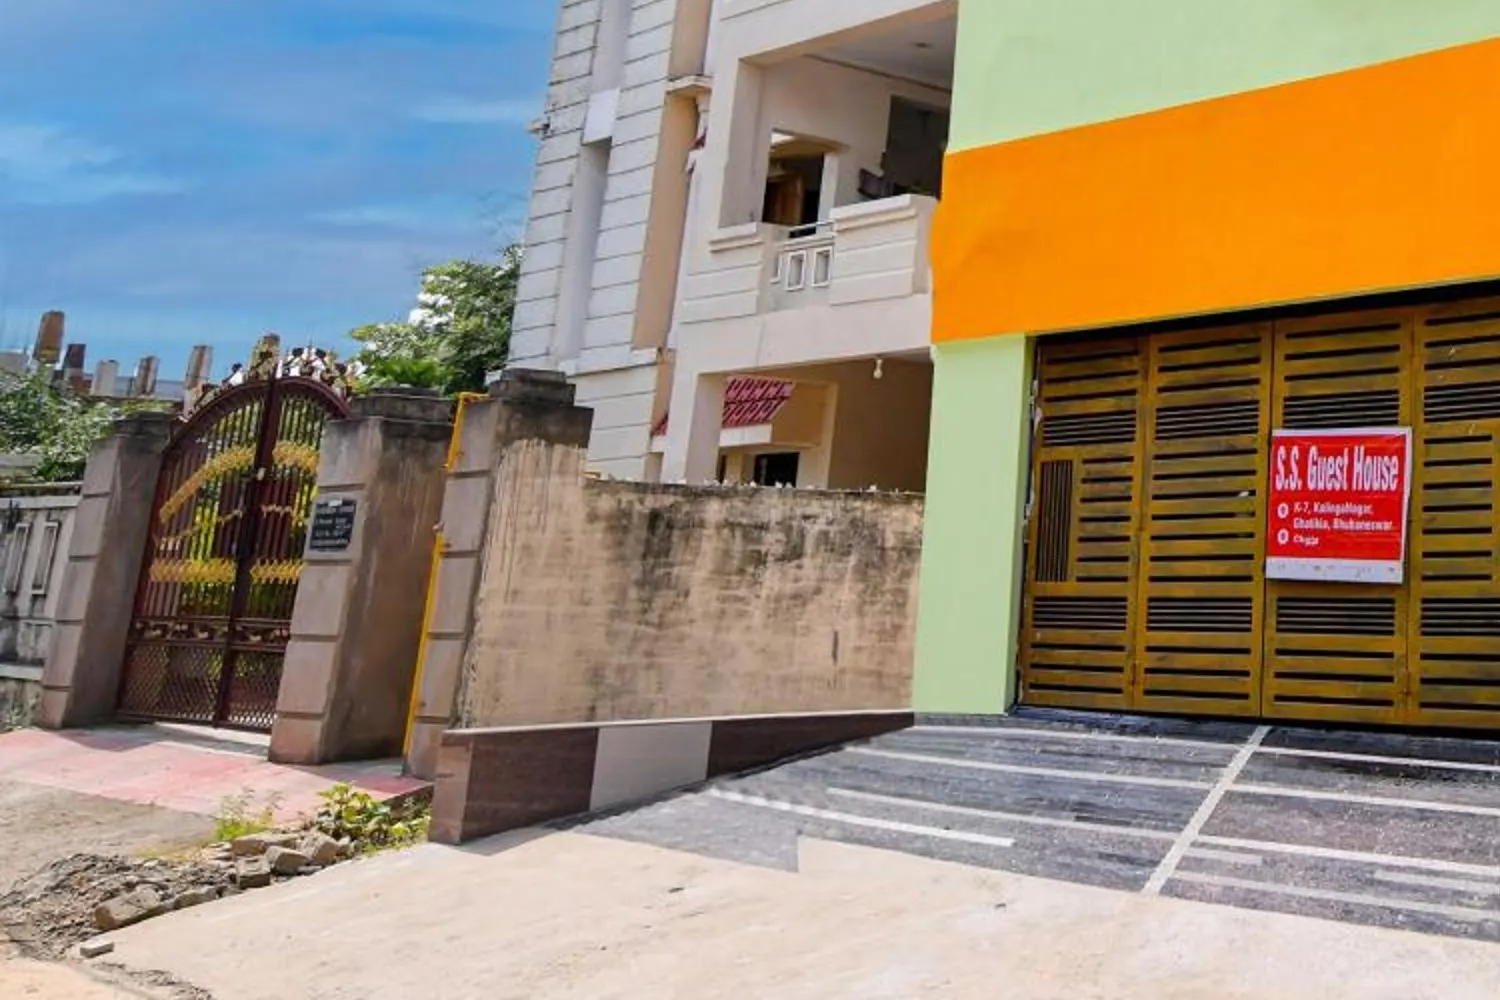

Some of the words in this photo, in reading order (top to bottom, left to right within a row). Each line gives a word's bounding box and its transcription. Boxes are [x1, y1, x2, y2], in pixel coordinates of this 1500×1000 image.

[1276, 445, 1302, 491] S.S.
[1307, 445, 1349, 491] Guest
[1352, 445, 1399, 491] House
